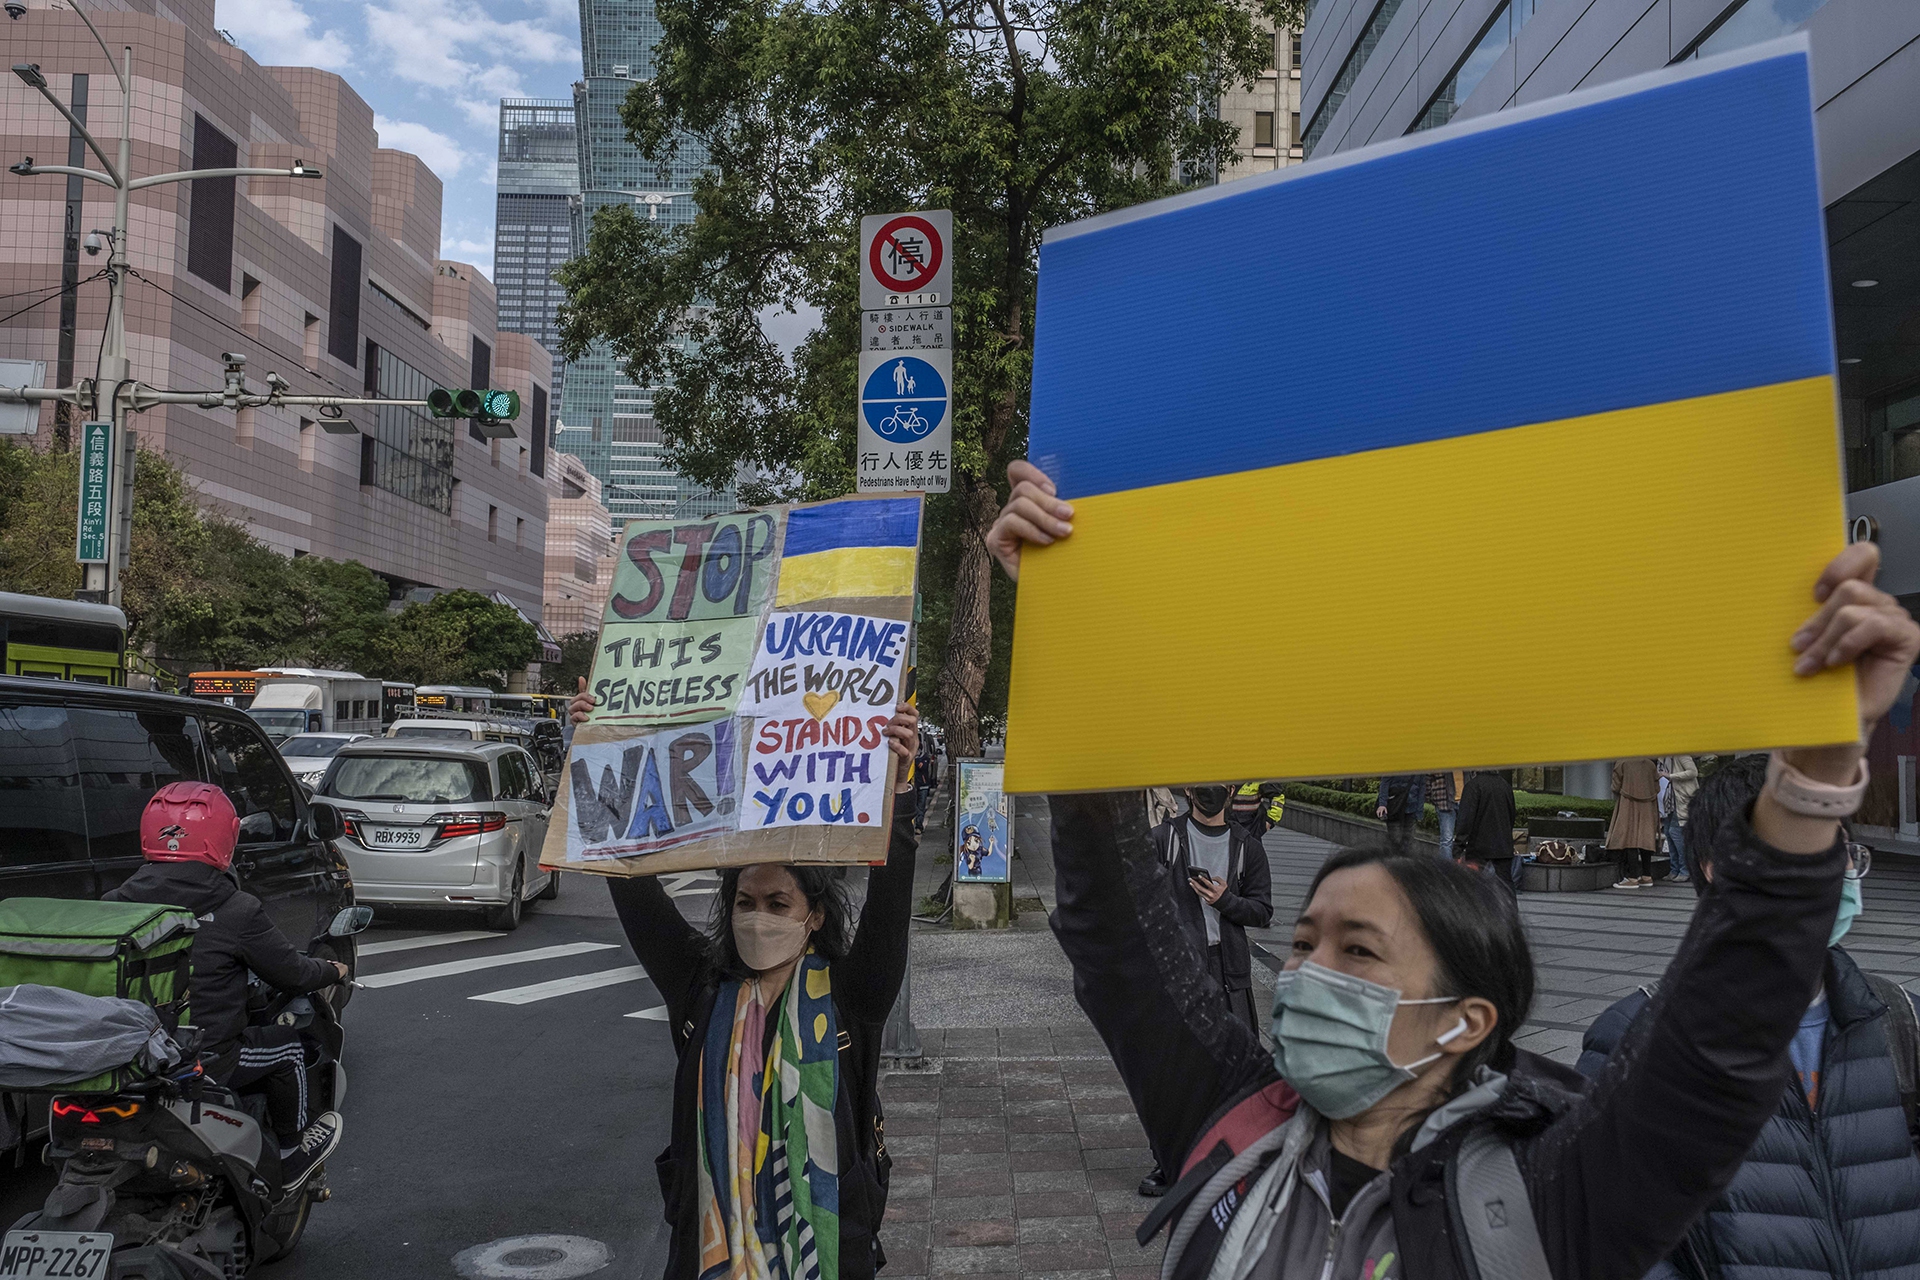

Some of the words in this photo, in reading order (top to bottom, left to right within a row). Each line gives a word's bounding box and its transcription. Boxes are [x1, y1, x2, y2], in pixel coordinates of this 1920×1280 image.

[888, 237, 924, 275] 停
[904, 293, 937, 304] 110
[889, 323, 934, 332] SIDEWALK
[87, 435, 105, 517] 信義路五段
[860, 450, 947, 471] 行人優先
[860, 476, 894, 487] Pedestrians
[895, 475, 909, 487] Have
[910, 475, 926, 488] Right
[927, 475, 934, 486] of
[935, 475, 948, 488] Way
[83, 518, 102, 526] XinYi
[611, 514, 777, 621] STOP
[604, 632, 722, 670] THIS
[765, 613, 906, 667] UKRAINE:
[593, 672, 739, 714] SENSELESS
[747, 662, 797, 707] THE
[804, 661, 895, 707] WORLD
[755, 715, 889, 755] STANDS
[571, 721, 736, 845] WAR!
[753, 750, 871, 787] WITH
[751, 787, 870, 827] YOU.
[375, 831, 421, 844] RBX-9939
[0, 1246, 106, 1278] MPP-2267
